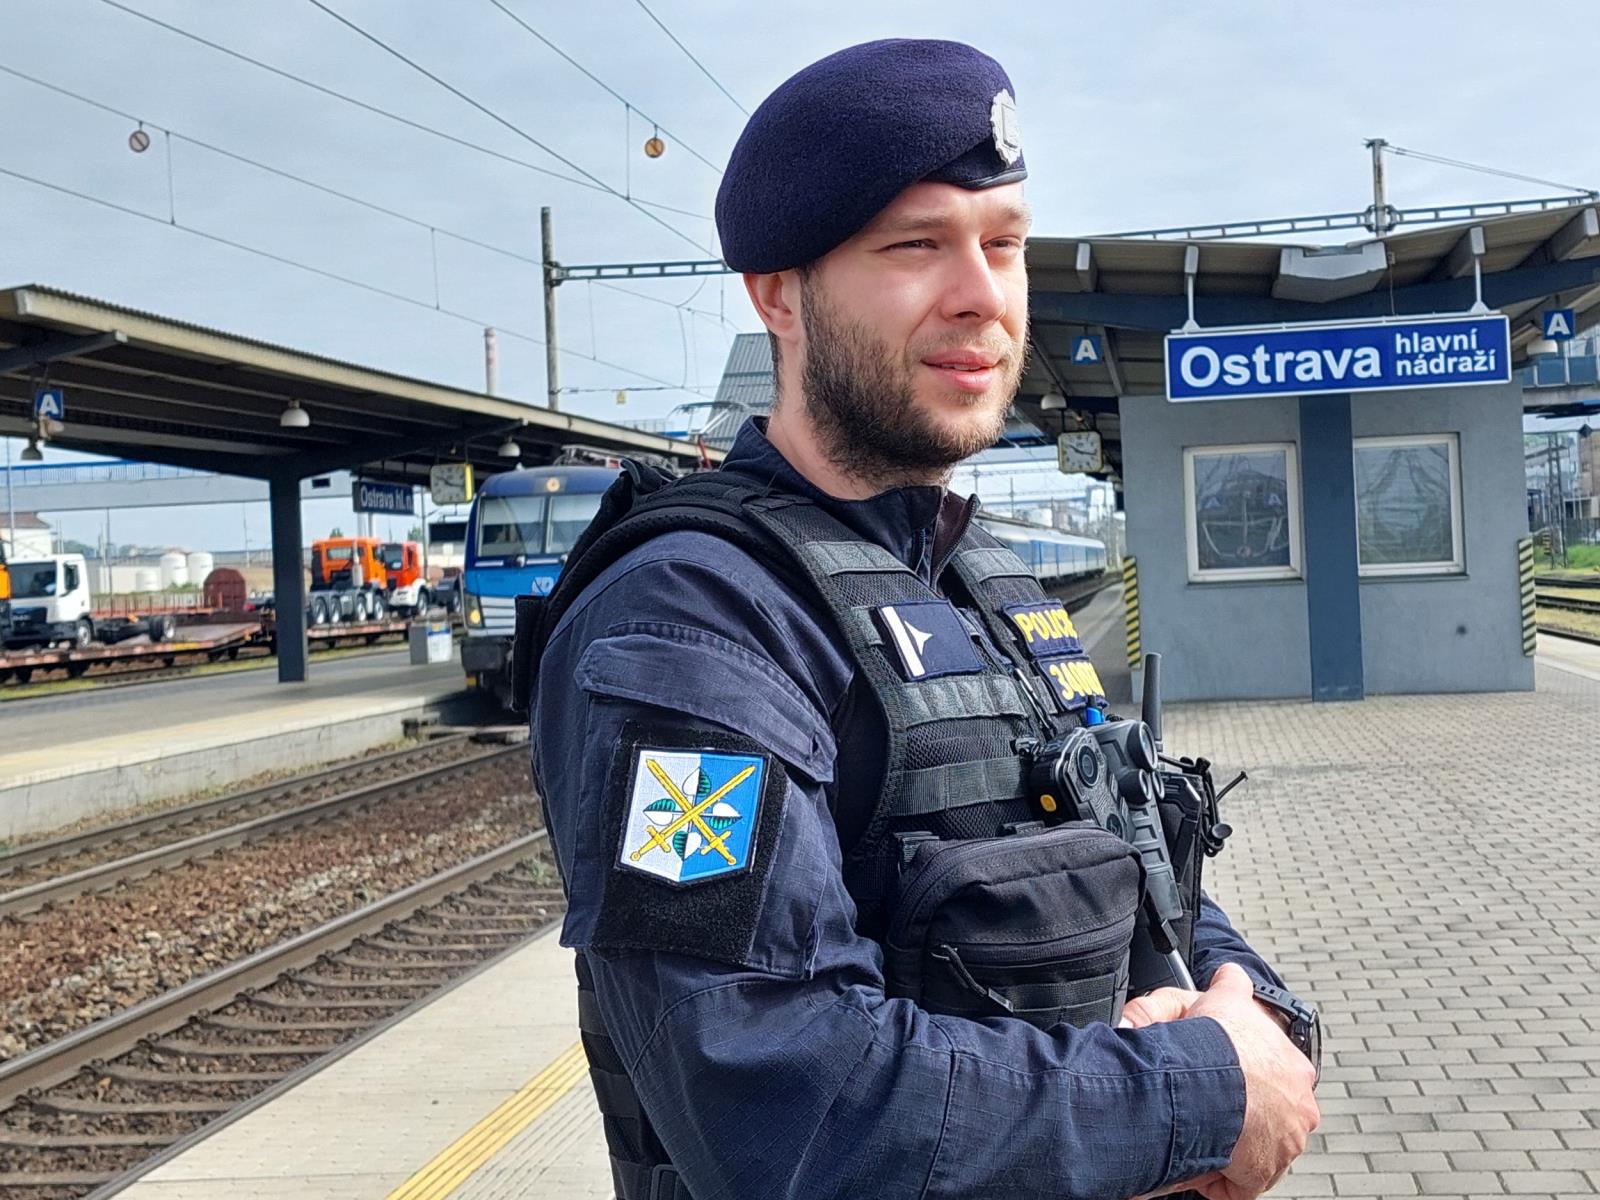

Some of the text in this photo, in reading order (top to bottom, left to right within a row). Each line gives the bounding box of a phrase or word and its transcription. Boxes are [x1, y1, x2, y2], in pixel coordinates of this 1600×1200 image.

[1546, 313, 1570, 336] A
[1075, 339, 1097, 361] A
[1180, 328, 1477, 388] Ostrava hlavní
[1396, 349, 1496, 376] nádraží
[40, 394, 59, 415] A
[360, 484, 394, 510] Ostrava
